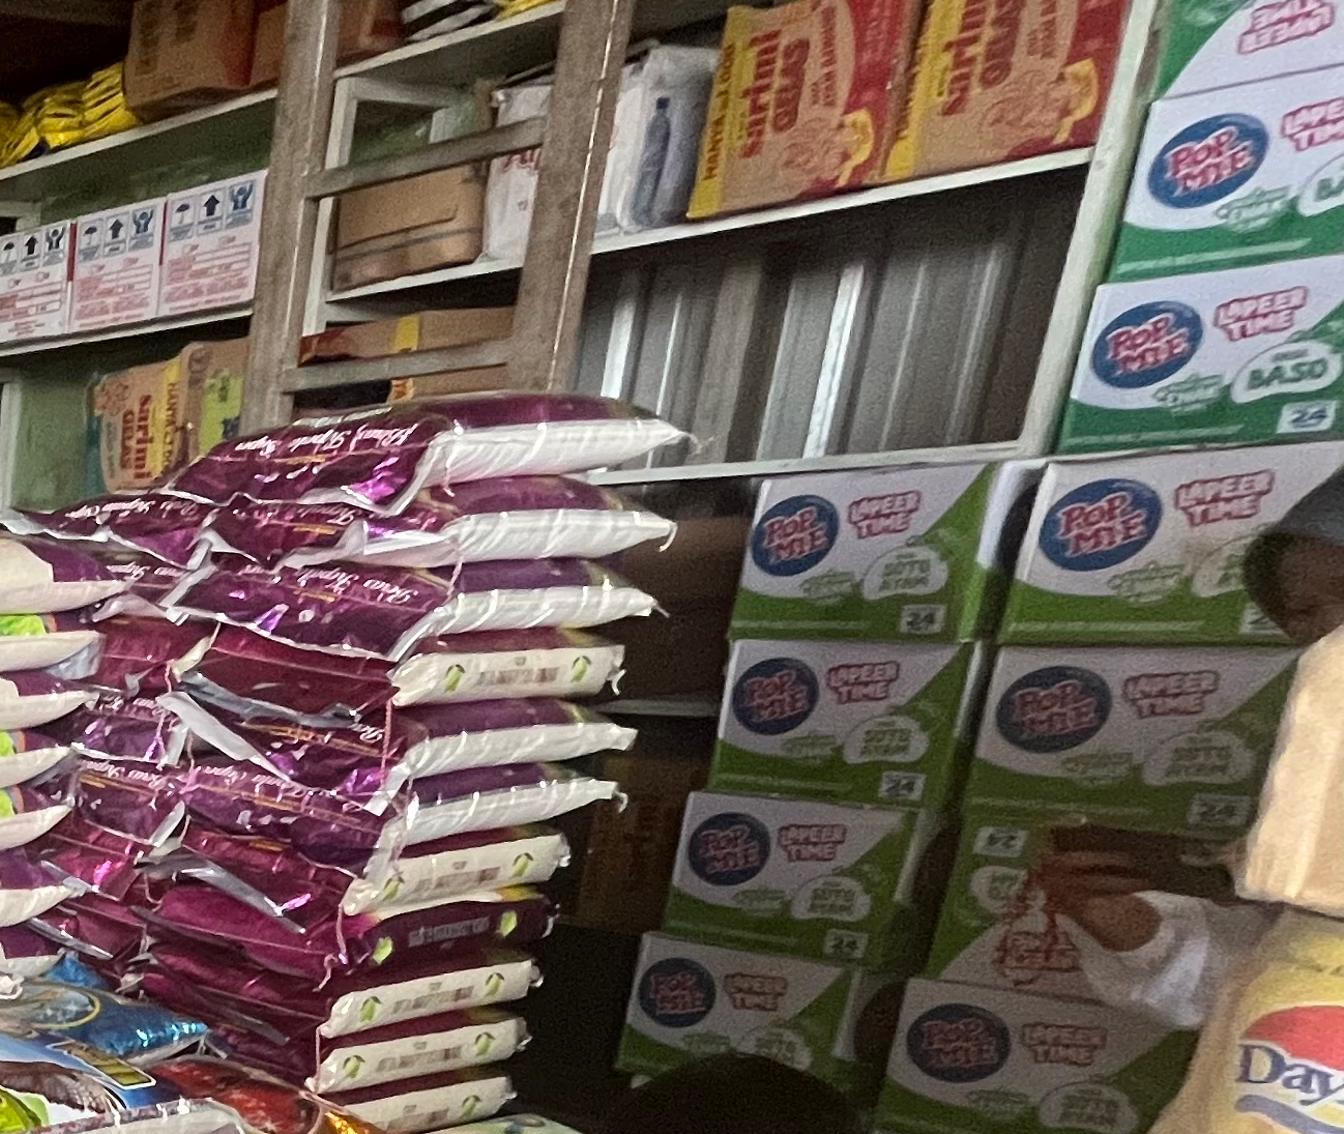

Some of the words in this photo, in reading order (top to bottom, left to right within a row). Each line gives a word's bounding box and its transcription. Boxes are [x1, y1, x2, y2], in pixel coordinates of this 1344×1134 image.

[1105, 312, 1177, 359] POP
[1246, 358, 1329, 390] BASO
[765, 505, 818, 548] POP
[1053, 493, 1132, 540] POP
